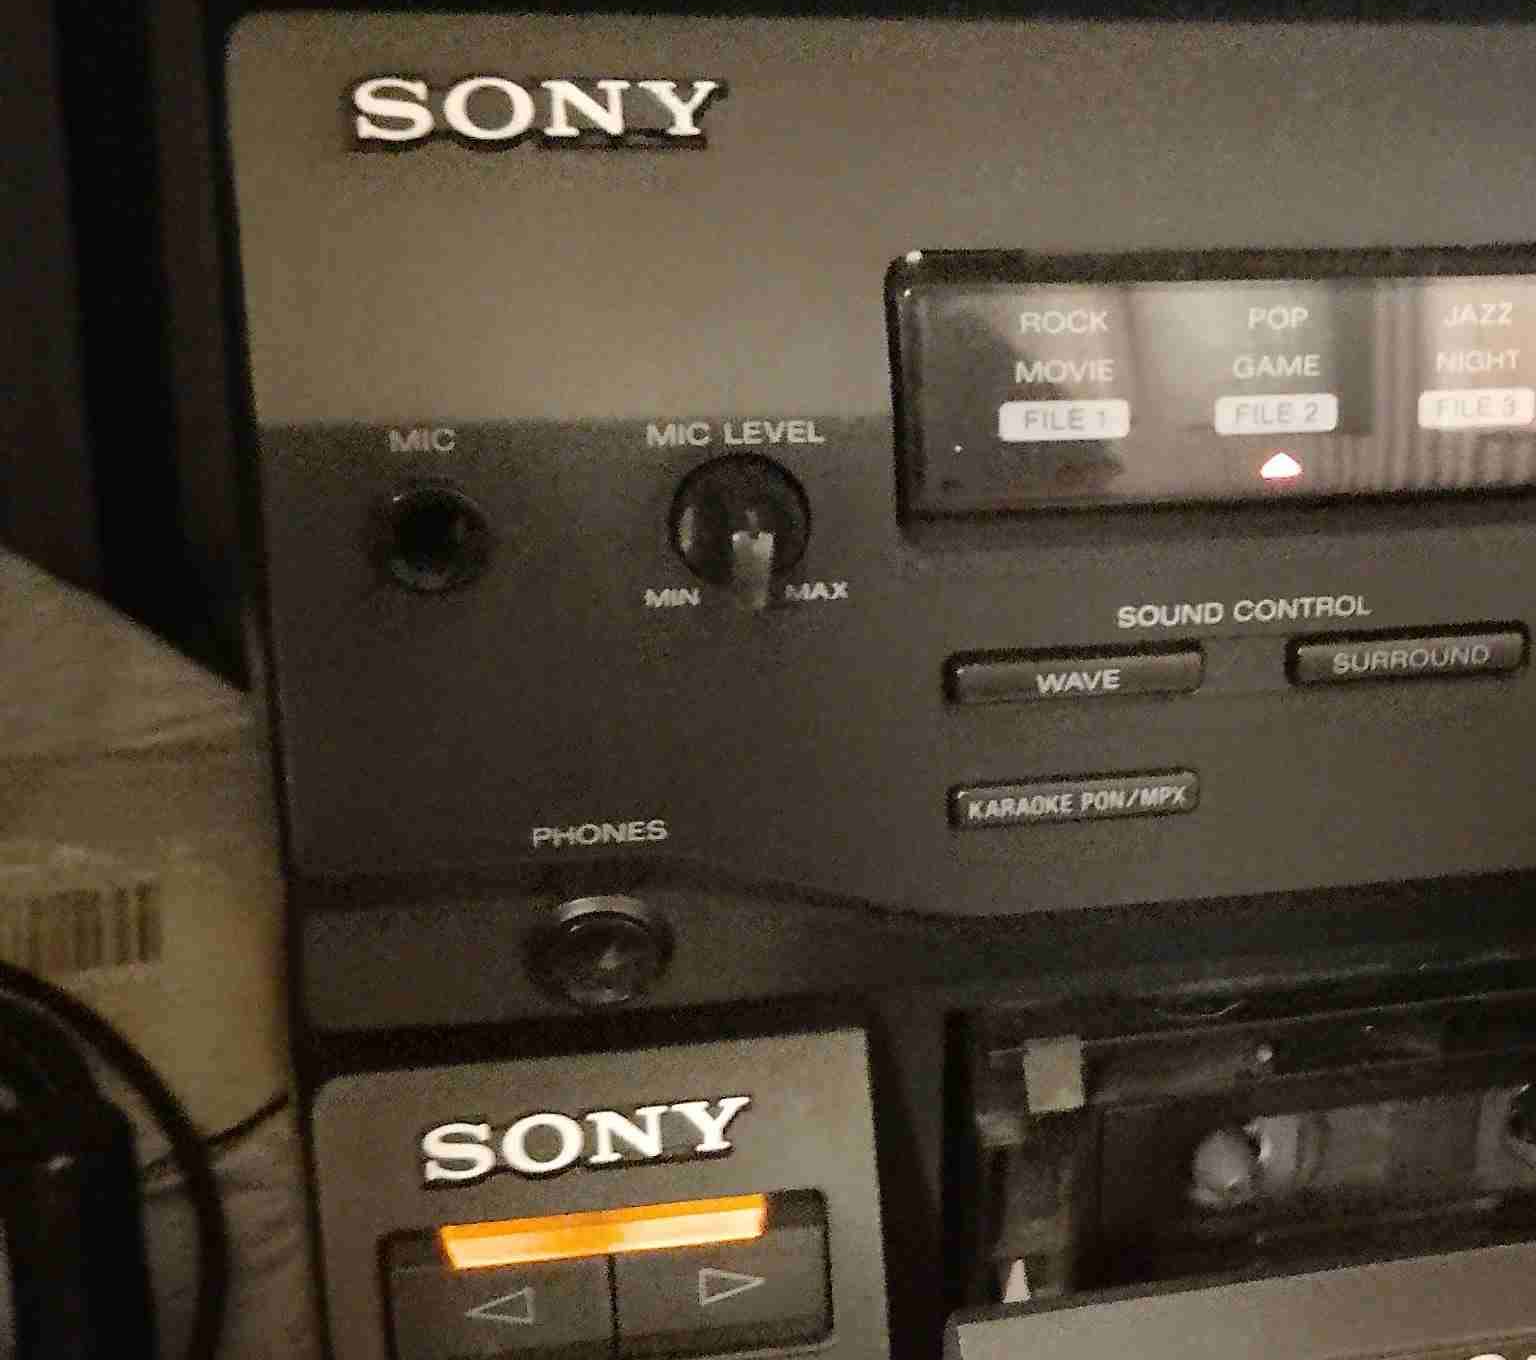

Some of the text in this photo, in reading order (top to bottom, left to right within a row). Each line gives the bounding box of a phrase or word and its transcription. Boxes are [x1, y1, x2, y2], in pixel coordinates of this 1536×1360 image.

[353, 77, 717, 140] SONY
[1019, 309, 1109, 334] ROCK
[1248, 307, 1309, 331] POP
[1444, 302, 1513, 327] JAZZ
[1016, 359, 1113, 384] MOVIE
[1232, 355, 1320, 380] GAME
[1435, 349, 1519, 372] NIGHT
[1023, 407, 1107, 431] FILE 1
[1235, 401, 1319, 426] FILE 2
[1437, 395, 1516, 418] FILE 3
[388, 429, 456, 453] MIC
[646, 420, 825, 447] MIC LEVEL
[644, 587, 701, 608] MIN
[785, 581, 848, 601] MAX
[1117, 595, 1373, 629] SOUND CONTROL
[1333, 644, 1490, 674] SURROUND
[1036, 669, 1121, 694] WAVE
[967, 786, 1190, 821] KARAOKE PON/MPX
[533, 820, 667, 847] PHONES
[421, 1096, 751, 1183] SONY
